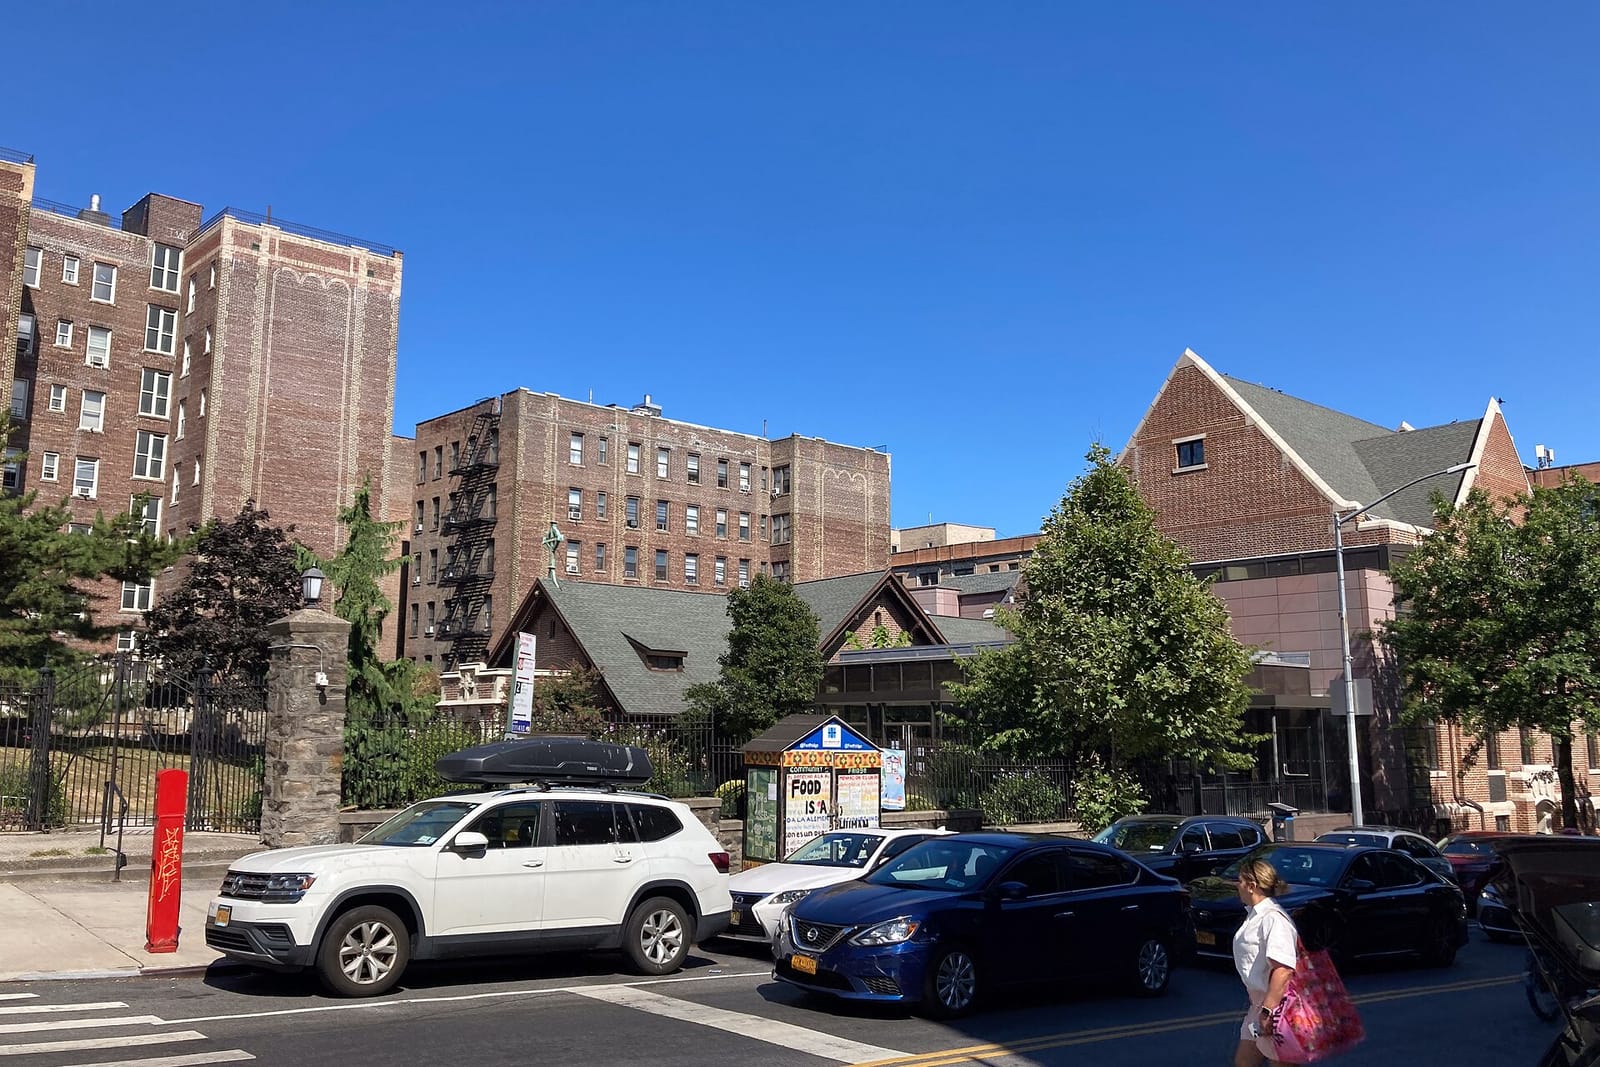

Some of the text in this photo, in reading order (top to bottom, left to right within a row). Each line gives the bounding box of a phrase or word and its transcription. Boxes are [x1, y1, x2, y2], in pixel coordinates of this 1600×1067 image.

[791, 779, 821, 798] FOOD
[805, 800, 827, 815] IS A
